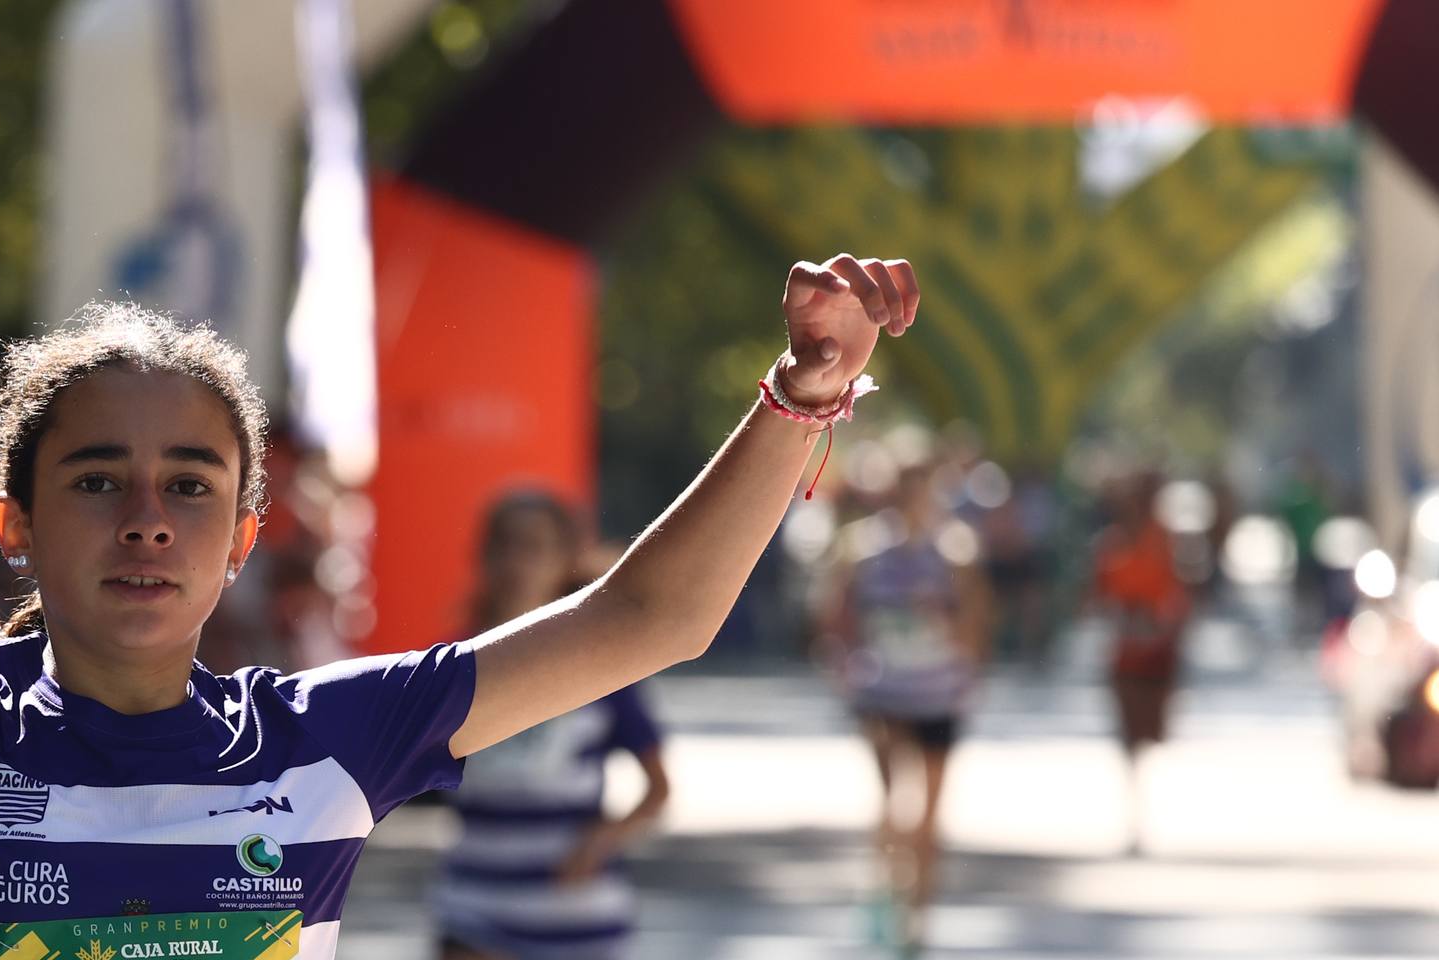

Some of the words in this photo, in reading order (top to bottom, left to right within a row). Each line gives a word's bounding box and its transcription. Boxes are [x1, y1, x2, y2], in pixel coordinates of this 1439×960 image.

[9, 861, 68, 883] CURA
[213, 877, 302, 892] CASTRILLO
[246, 892, 271, 900] BAÑOS
[121, 942, 165, 958] CAJA
[168, 940, 223, 956] RURAL
